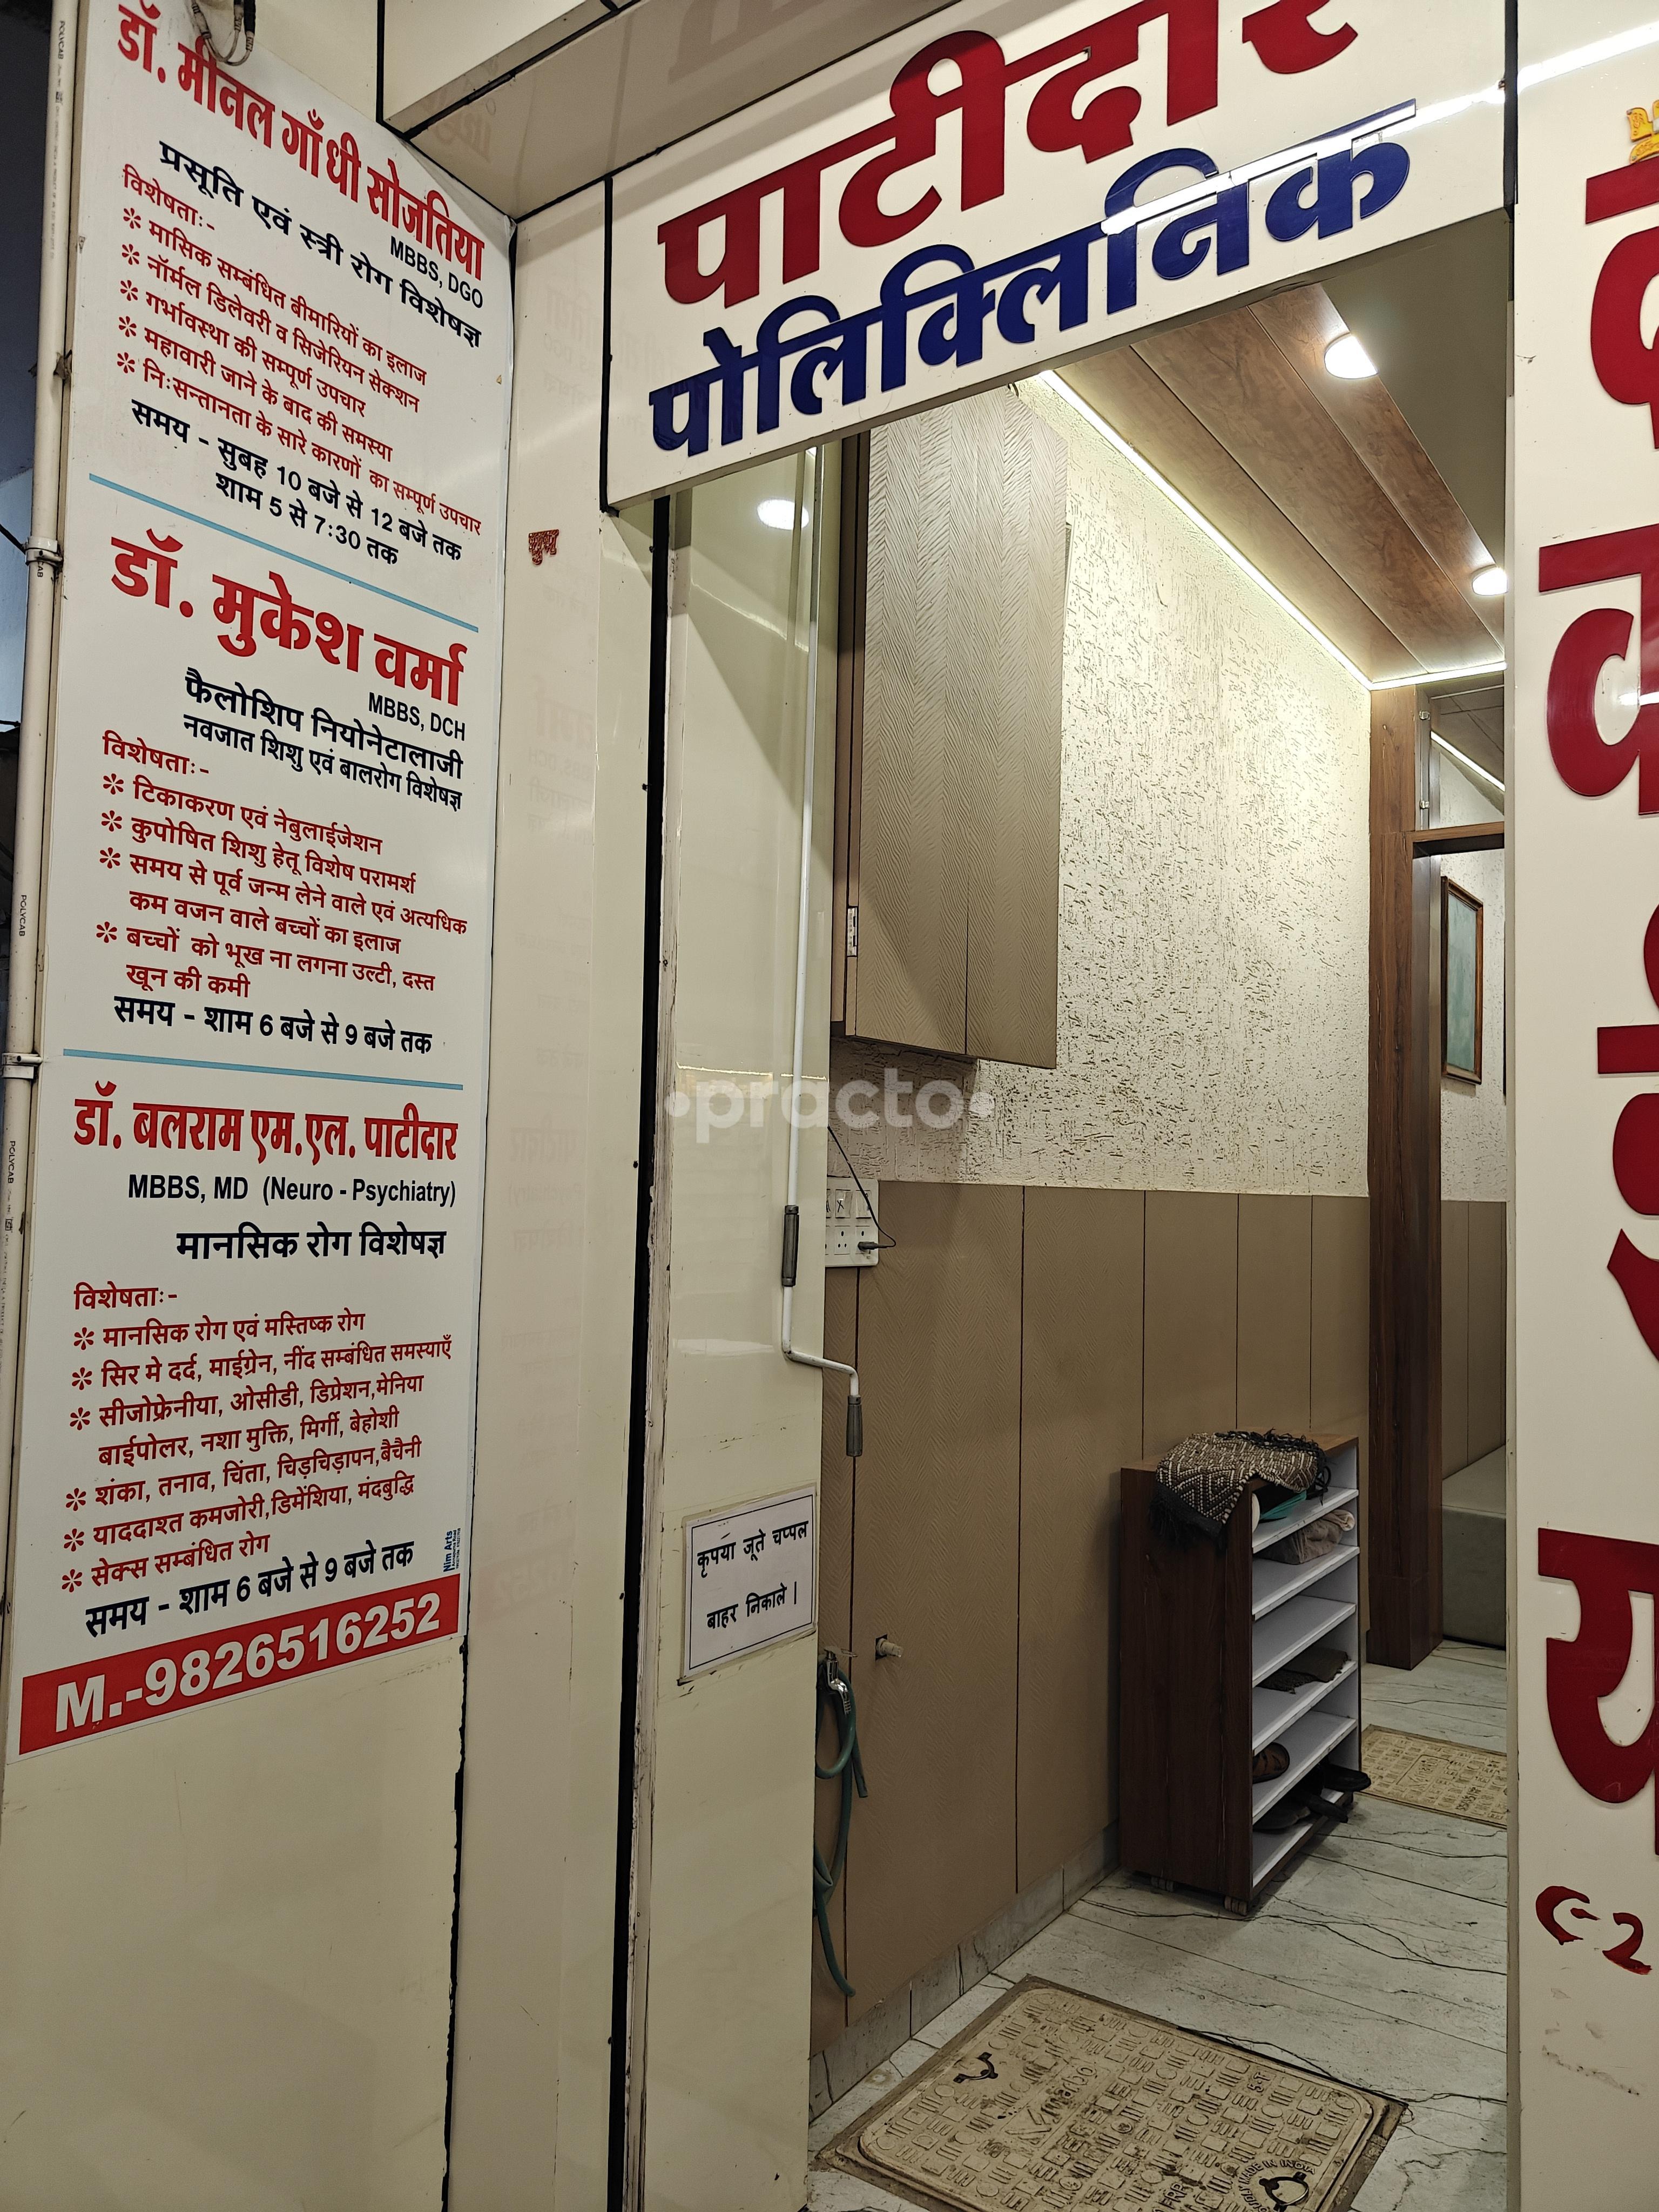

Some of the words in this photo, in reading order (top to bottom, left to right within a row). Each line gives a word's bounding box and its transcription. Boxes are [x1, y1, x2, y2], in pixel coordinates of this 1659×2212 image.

[118, 0, 166, 83] डॉ.
[178, 36, 275, 149] मीनल
[282, 109, 361, 203] गाँधी
[367, 158, 484, 281] सोजतिया
[159, 140, 244, 207] प्रसूति
[252, 195, 292, 235] एवं
[300, 224, 343, 266] स्त्री
[350, 252, 393, 295] रोग
[400, 279, 482, 347] विशेषज्ञ
[391, 235, 442, 288] MBBS,
[448, 272, 483, 308] DGO
[149, 220, 212, 267] मासिक
[217, 258, 286, 309] सम्बंधित
[291, 295, 359, 348] बीमारियों
[362, 337, 383, 361] का
[386, 350, 427, 386] इलाज
[649, 99, 1416, 457] पोलिक्लिनिक
[146, 292, 230, 348] गर्भावस्था
[234, 336, 258, 362] की
[262, 350, 312, 390] सम्पूर्ण
[316, 378, 366, 417] उपचार
[147, 254, 201, 299] नॉर्मल
[206, 282, 272, 335] डिलेवरी
[276, 323, 288, 344] व
[292, 327, 365, 385] सिजेरियन
[369, 369, 420, 413] सेक्शन
[144, 327, 216, 377] महावारी
[221, 365, 257, 396] जाने
[262, 379, 278, 405] के
[283, 395, 313, 424] बाद
[316, 411, 338, 436] की
[342, 424, 393, 462] समस्या
[132, 399, 190, 443] समय
[218, 437, 268, 479] सुबह
[277, 466, 301, 490] 10
[308, 478, 340, 509] बजे
[346, 490, 363, 520] से
[372, 508, 392, 532] 12
[399, 518, 428, 548] बजे
[433, 534, 462, 560] तक
[256, 410, 273, 436] के
[277, 426, 307, 455] सारे
[312, 442, 362, 479] कारणों
[369, 469, 389, 493] का
[393, 481, 436, 515] सम्पूर्ण
[439, 503, 481, 536] उपचार
[215, 473, 263, 510] शाम
[269, 496, 282, 517] 5
[289, 498, 307, 529] से
[314, 515, 360, 549] 7:30
[366, 537, 399, 564] तक
[111, 528, 193, 617] डॉ.
[212, 571, 364, 672] मुकेश
[374, 633, 468, 706] वर्मा
[185, 667, 304, 732] फैलोशिप
[369, 692, 424, 731] MBBS,
[430, 712, 465, 741] DCH
[184, 714, 255, 752] नवजात
[260, 729, 304, 772] शिशु
[309, 748, 335, 775] एवं
[406, 771, 462, 812] विशेषज्ञ
[133, 774, 235, 821] टिकाकरण
[240, 806, 268, 830] एवं
[131, 817, 216, 852] कुपोषित
[221, 831, 267, 868] शिशु
[305, 849, 355, 881] विशेष
[360, 867, 416, 894] परामर्श
[18, 894, 27, 937] POLYCAB
[130, 854, 183, 881] समय
[188, 859, 207, 886] से
[213, 868, 244, 896] पूर्व
[248, 878, 290, 901] जन्म
[295, 881, 326, 908] लेने
[332, 892, 367, 916] वाले
[371, 900, 395, 923] एवं
[400, 908, 467, 934] अत्यधिक
[130, 891, 168, 914] कम
[174, 899, 225, 923] वजन
[230, 907, 269, 932] वाले
[275, 916, 320, 940] बच्चों
[324, 926, 349, 945] का
[353, 931, 401, 954] इलाज
[126, 926, 180, 952] बच्चों
[191, 933, 219, 958] को
[225, 943, 265, 968] भूख
[270, 950, 292, 969] ना
[296, 954, 348, 977] लगना
[402, 972, 435, 991] दस्त
[126, 965, 168, 992] खून
[173, 966, 202, 991] की
[207, 973, 251, 997] कमी
[114, 996, 176, 1027] समय
[204, 1007, 253, 1035] शाम
[260, 1014, 273, 1036] 6
[280, 1009, 315, 1041] बजे
[321, 1012, 339, 1044] से
[346, 1024, 357, 1045] 9
[364, 1020, 395, 1050] बजे
[401, 1031, 432, 1054] तक
[74, 1081, 122, 1149] डॉ.
[133, 1103, 245, 1151] बलराम
[364, 1103, 458, 1160] पाटीदार
[8, 1140, 16, 1184] POLYCAB
[129, 1175, 205, 1203] MBBS,
[214, 1177, 248, 1199] MD
[264, 1176, 333, 1206] (Neuro
[353, 1179, 455, 1208] Psychiatry)
[176, 1222, 299, 1259] मानसिक
[306, 1222, 352, 1257] रोग
[359, 1222, 447, 1259] विशेषज्ञ
[103, 1318, 190, 1347] मानसिक
[195, 1315, 228, 1341] रोग
[233, 1313, 260, 1342] एवं
[338, 1307, 366, 1332] रोग
[101, 1359, 140, 1387] सिर
[145, 1356, 162, 1382] मे
[321, 1340, 386, 1367] सम्बंधित
[201, 1430, 242, 1452] नशा
[350, 1405, 400, 1434] बेहोशी
[158, 1471, 215, 1496] तनाव,
[91, 1557, 149, 1587] सेक्स
[239, 1530, 270, 1557] रोग
[443, 1553, 455, 1572] Nim
[444, 1530, 453, 1550] Arts
[697, 1542, 736, 1578] कृपया
[743, 1529, 766, 1561] जूते
[772, 1520, 809, 1545] चप्पल
[85, 1596, 149, 1637] समय
[179, 1579, 230, 1615] शाम
[237, 1576, 250, 1602] 6
[258, 1556, 294, 1597] बजे
[300, 1551, 319, 1589] से
[325, 1557, 337, 1582] 9
[344, 1540, 376, 1578] बजे
[381, 1541, 414, 1571] तक
[706, 1603, 738, 1629] बाहर
[746, 1582, 787, 1617] निकाले
[1238, 2162, 1264, 2185] MADE
[1280, 2159, 1316, 2175] INDIA
